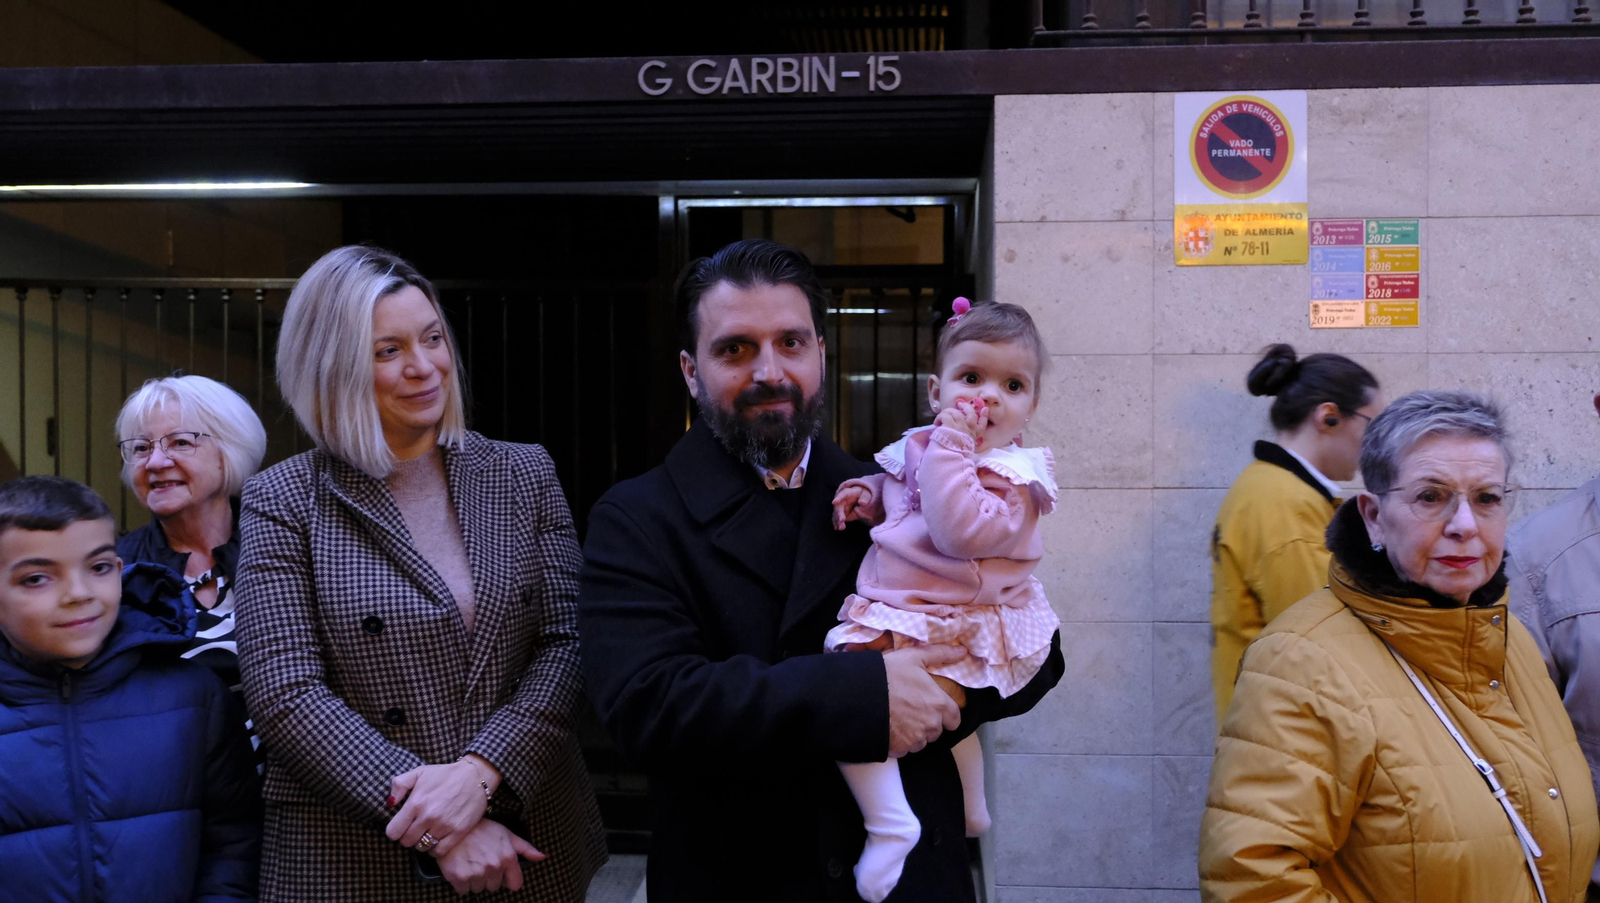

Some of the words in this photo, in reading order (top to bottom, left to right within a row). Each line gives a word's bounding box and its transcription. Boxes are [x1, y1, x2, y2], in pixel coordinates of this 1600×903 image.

[1199, 109, 1224, 139] SALIDA
[1225, 103, 1239, 114] DE
[1241, 103, 1285, 138] VEHICULOS
[1229, 138, 1254, 148] VADO
[1211, 148, 1272, 158] PERMANENTE
[1214, 212, 1304, 222] AYUNTAMIENTO
[1224, 228, 1240, 237] DE
[1312, 235, 1337, 245] 2013
[1367, 233, 1393, 244] 2015
[1240, 240, 1270, 256] 78-11
[1313, 261, 1337, 272] 2014
[1369, 261, 1392, 272] 2016
[1367, 288, 1393, 298] 2018
[1311, 315, 1336, 325] 2019
[1368, 315, 1393, 326] 2022
